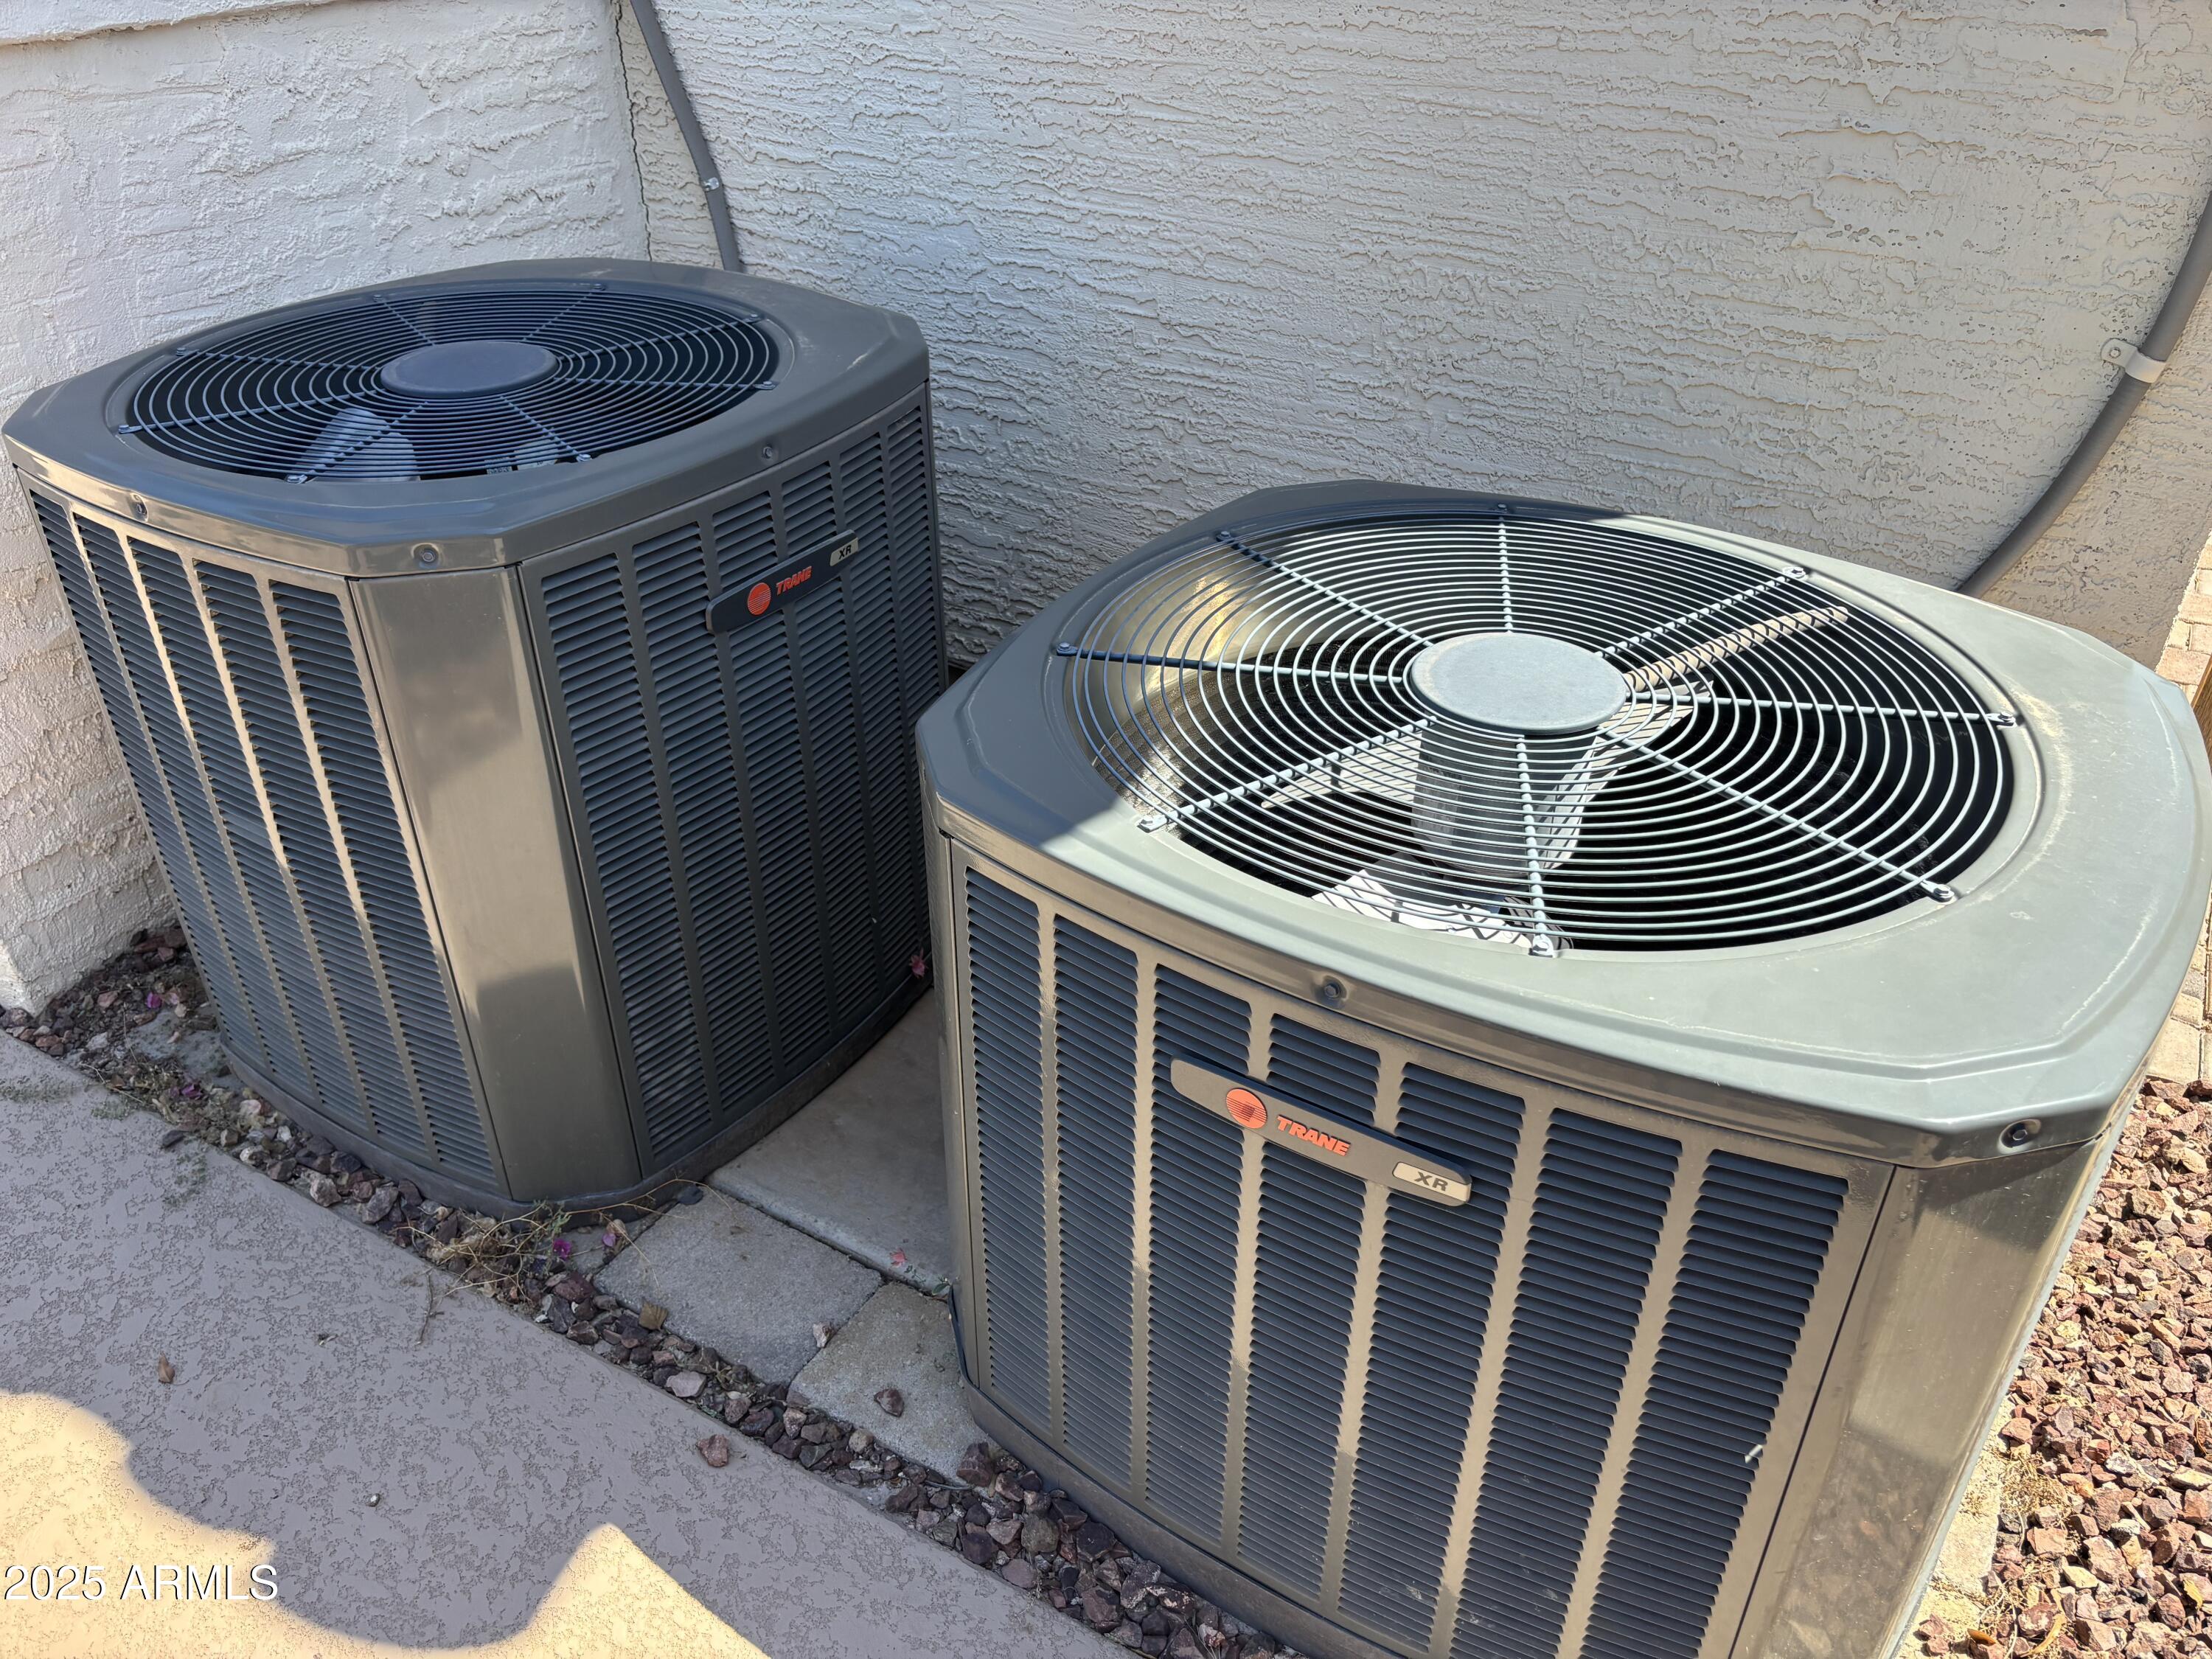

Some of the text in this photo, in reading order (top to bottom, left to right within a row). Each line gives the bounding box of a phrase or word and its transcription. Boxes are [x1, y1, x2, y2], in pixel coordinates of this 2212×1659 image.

[776, 544, 852, 596] TRANE XR
[1277, 1114, 1449, 1192] TRANE XR
